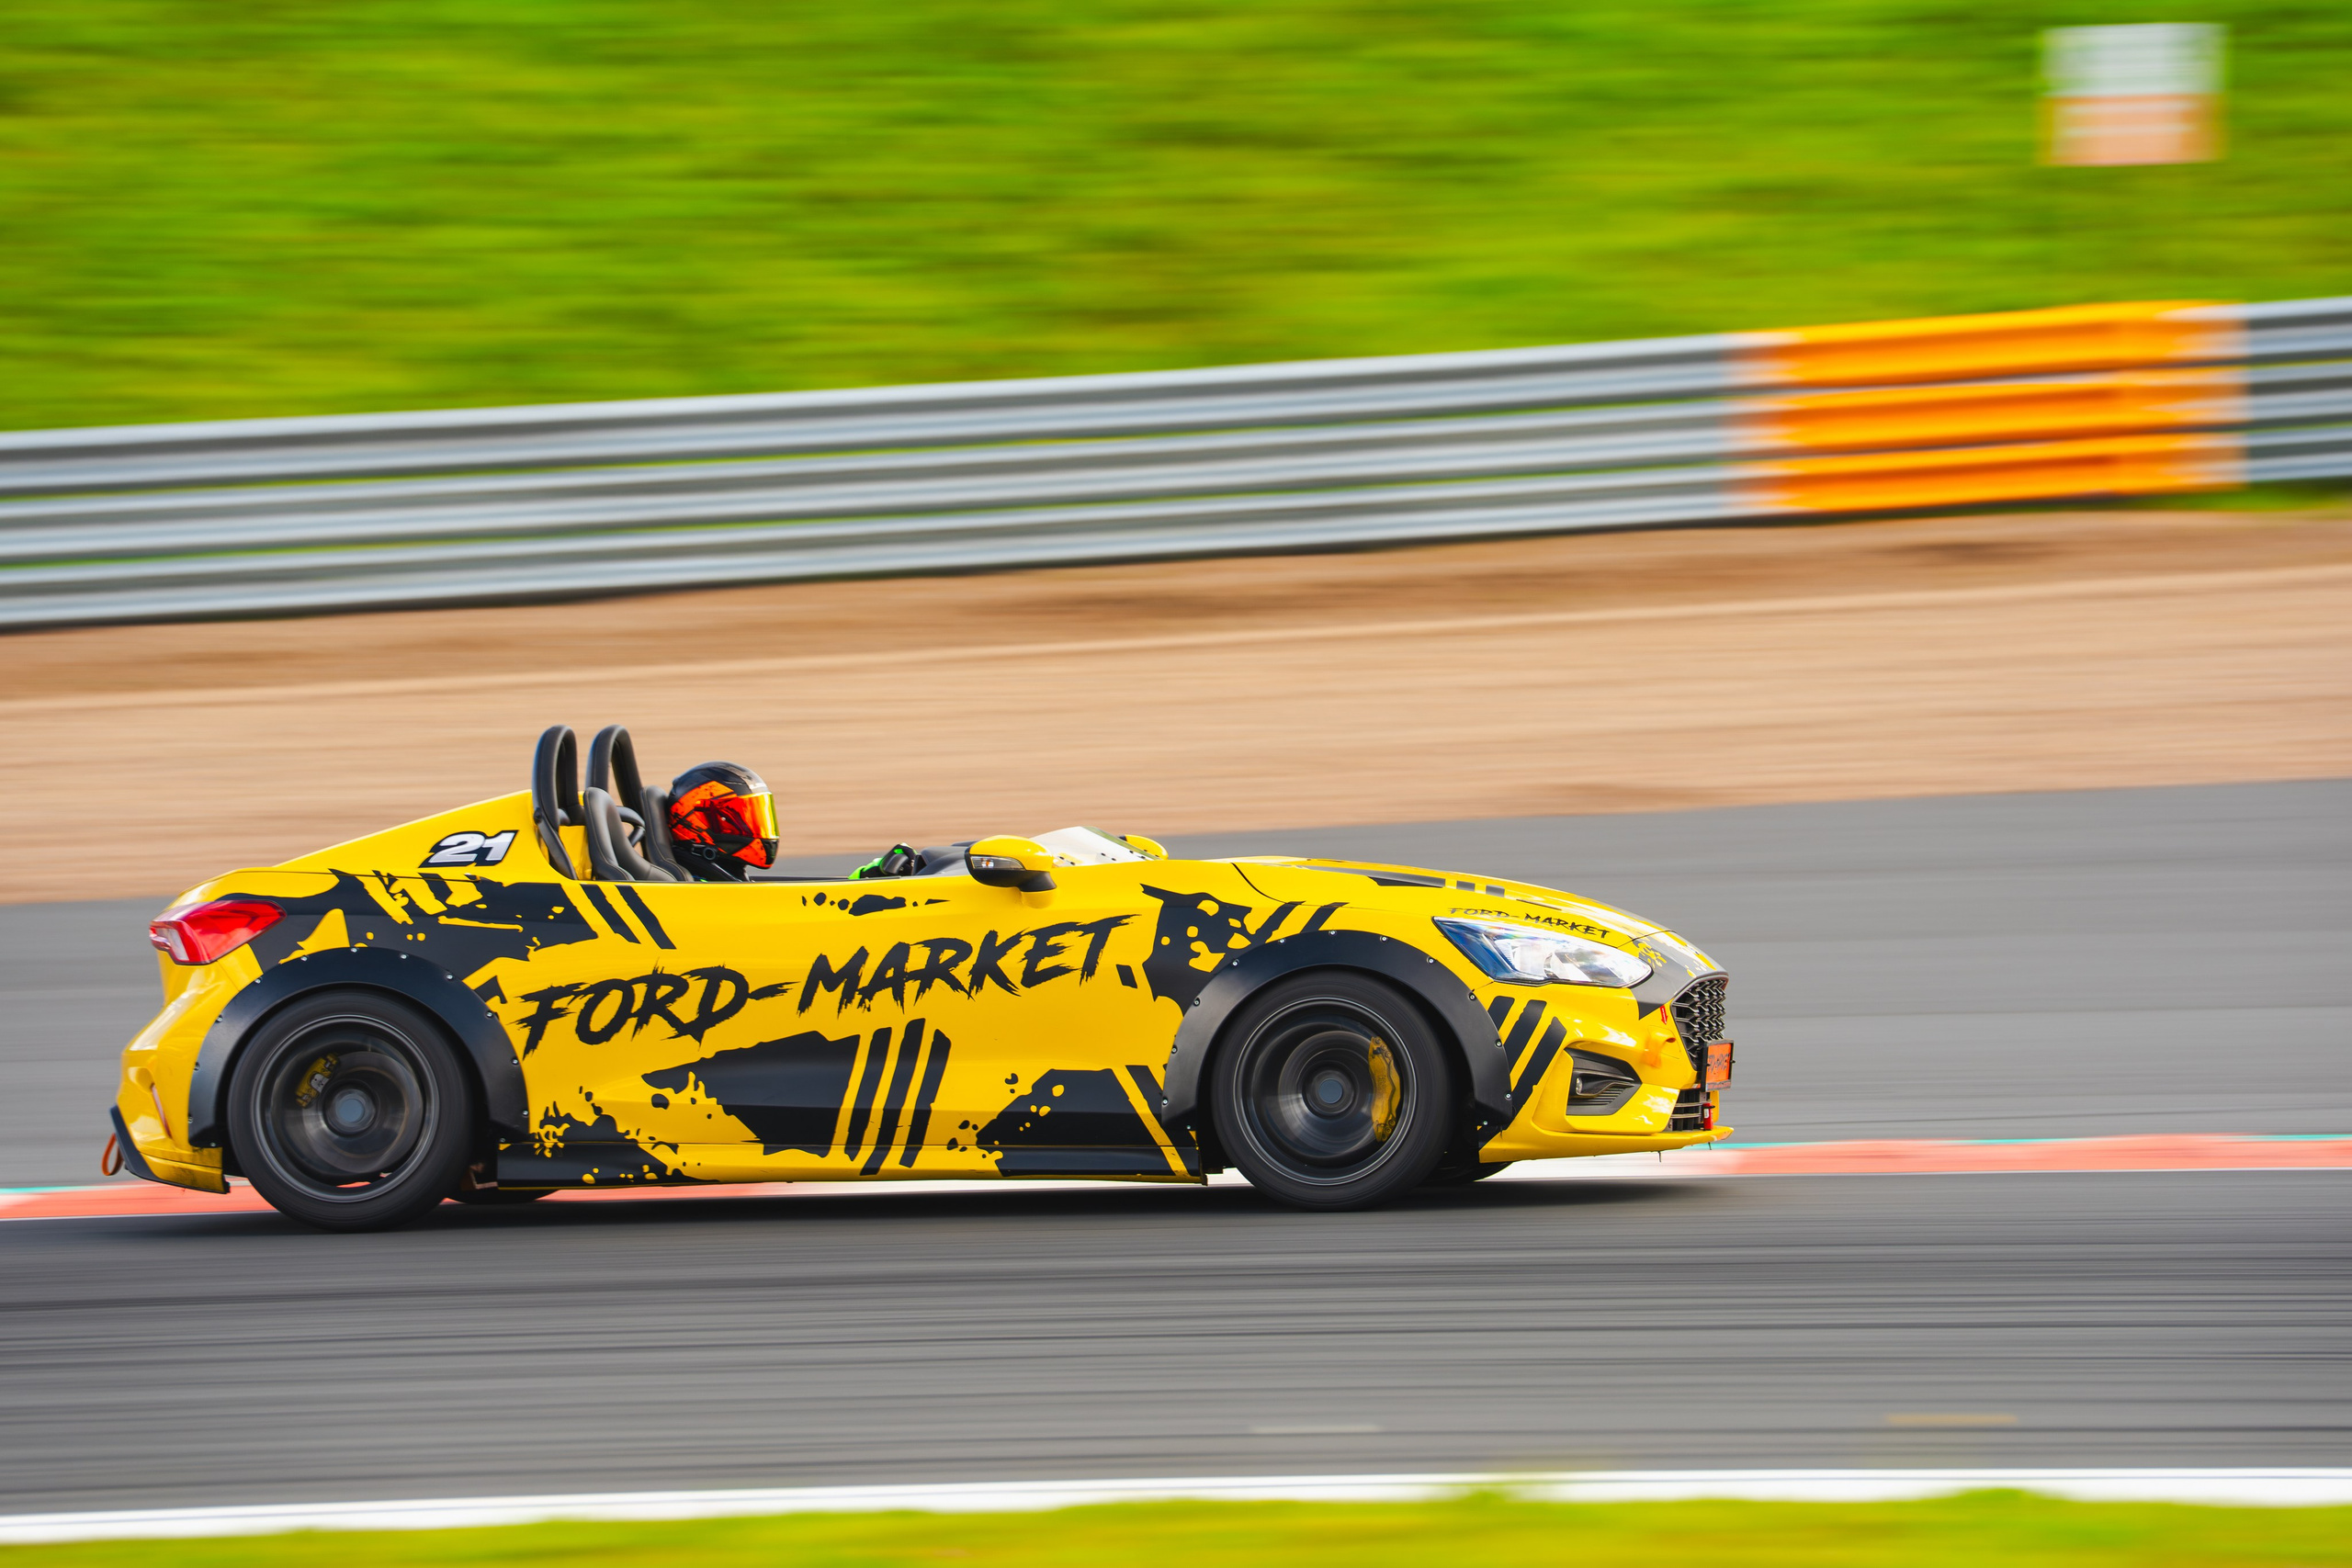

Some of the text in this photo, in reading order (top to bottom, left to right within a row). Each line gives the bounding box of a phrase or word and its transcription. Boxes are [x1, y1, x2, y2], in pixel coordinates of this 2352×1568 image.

[424, 830, 518, 867] 21
[1449, 908, 1611, 939] FORD-MARKET
[514, 914, 1141, 1060] FORD-MARKET
